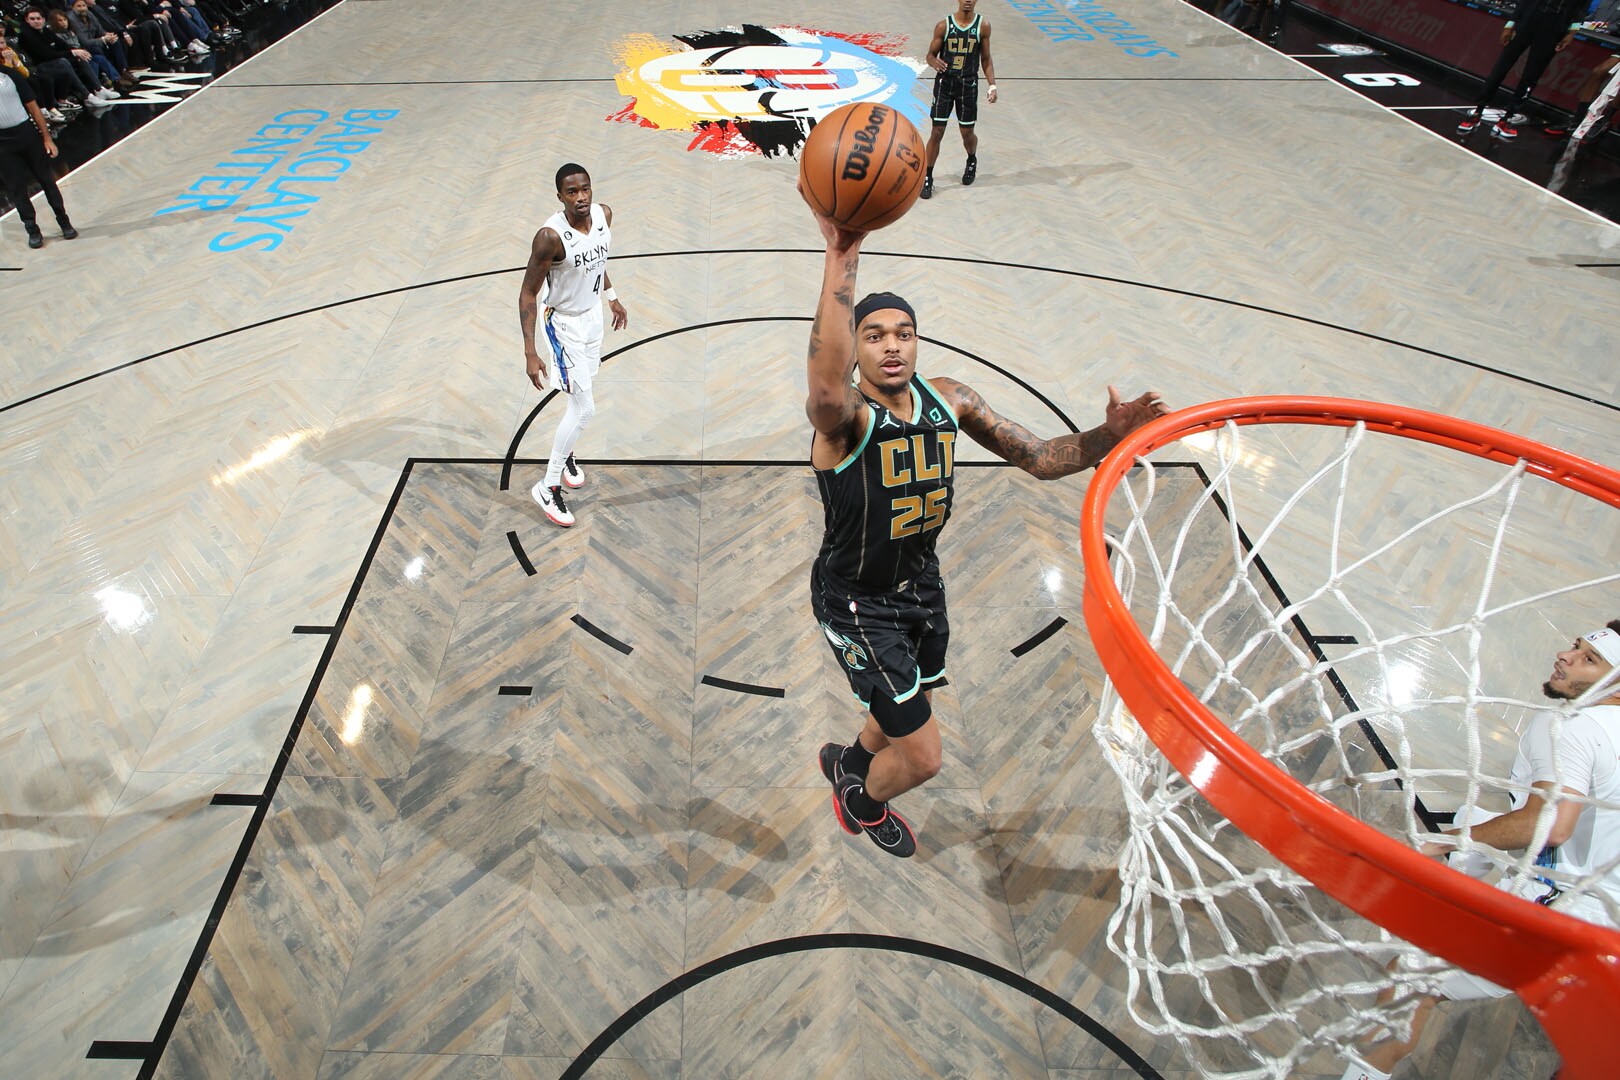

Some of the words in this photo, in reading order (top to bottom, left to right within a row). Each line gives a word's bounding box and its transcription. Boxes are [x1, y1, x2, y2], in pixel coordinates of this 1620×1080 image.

[947, 37, 977, 54] CLT
[1008, 0, 1095, 43] ENTER
[1055, 0, 1180, 58] ARCLAYS
[952, 55, 965, 70] 9
[153, 110, 330, 217] CENTER
[841, 105, 889, 182] Wilson
[208, 109, 400, 253] BARCLAYS
[574, 243, 608, 267] BKLYN
[592, 274, 601, 294] 4
[878, 432, 956, 488] CLT
[890, 487, 948, 540] 25
